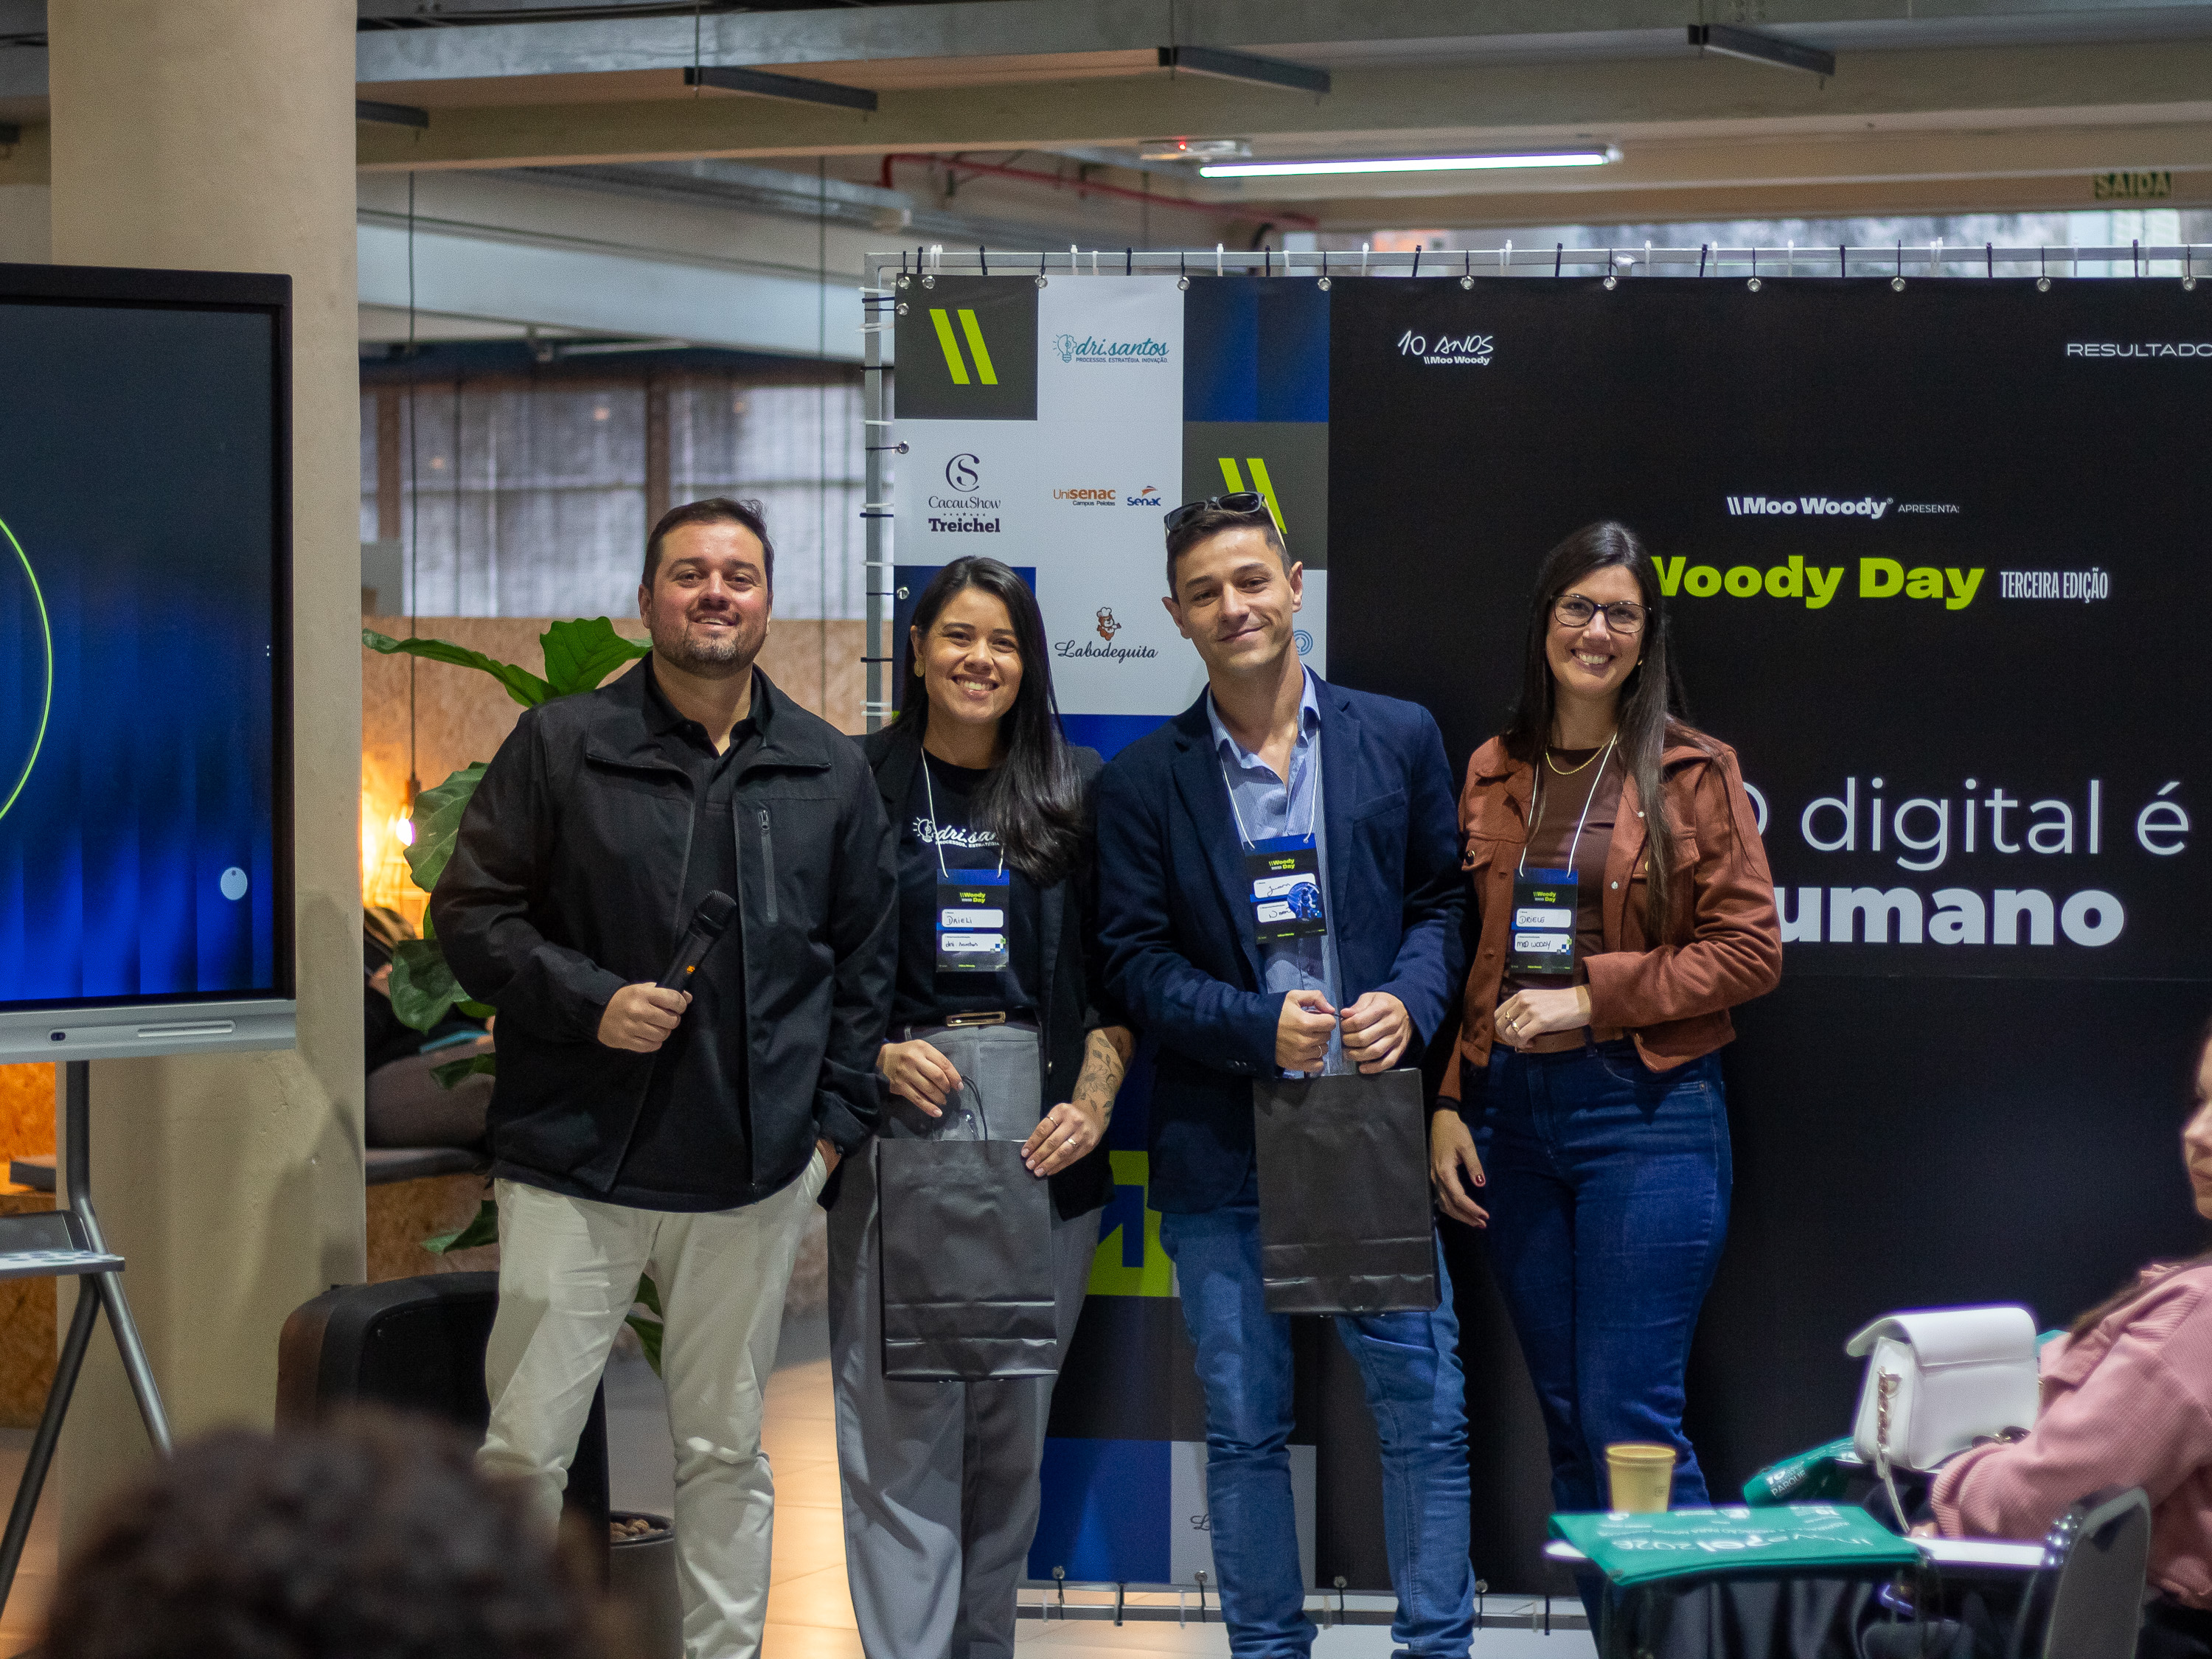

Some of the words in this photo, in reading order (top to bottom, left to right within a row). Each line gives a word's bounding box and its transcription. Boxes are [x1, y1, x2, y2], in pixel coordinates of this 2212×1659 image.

[1397, 330, 1426, 355] 10
[1434, 335, 1494, 355] ANOS
[1053, 489, 1116, 501] Unisenac
[928, 518, 1001, 532] Treichel
[1860, 557, 1985, 611] Day
[2000, 571, 2059, 599] TERCEIRA
[2063, 567, 2109, 604] EDIÇÃO
[1054, 639, 1159, 664] Labodeguita
[1801, 776, 2100, 872] digital
[2138, 781, 2190, 856] é
[1773, 886, 2125, 947] umano
